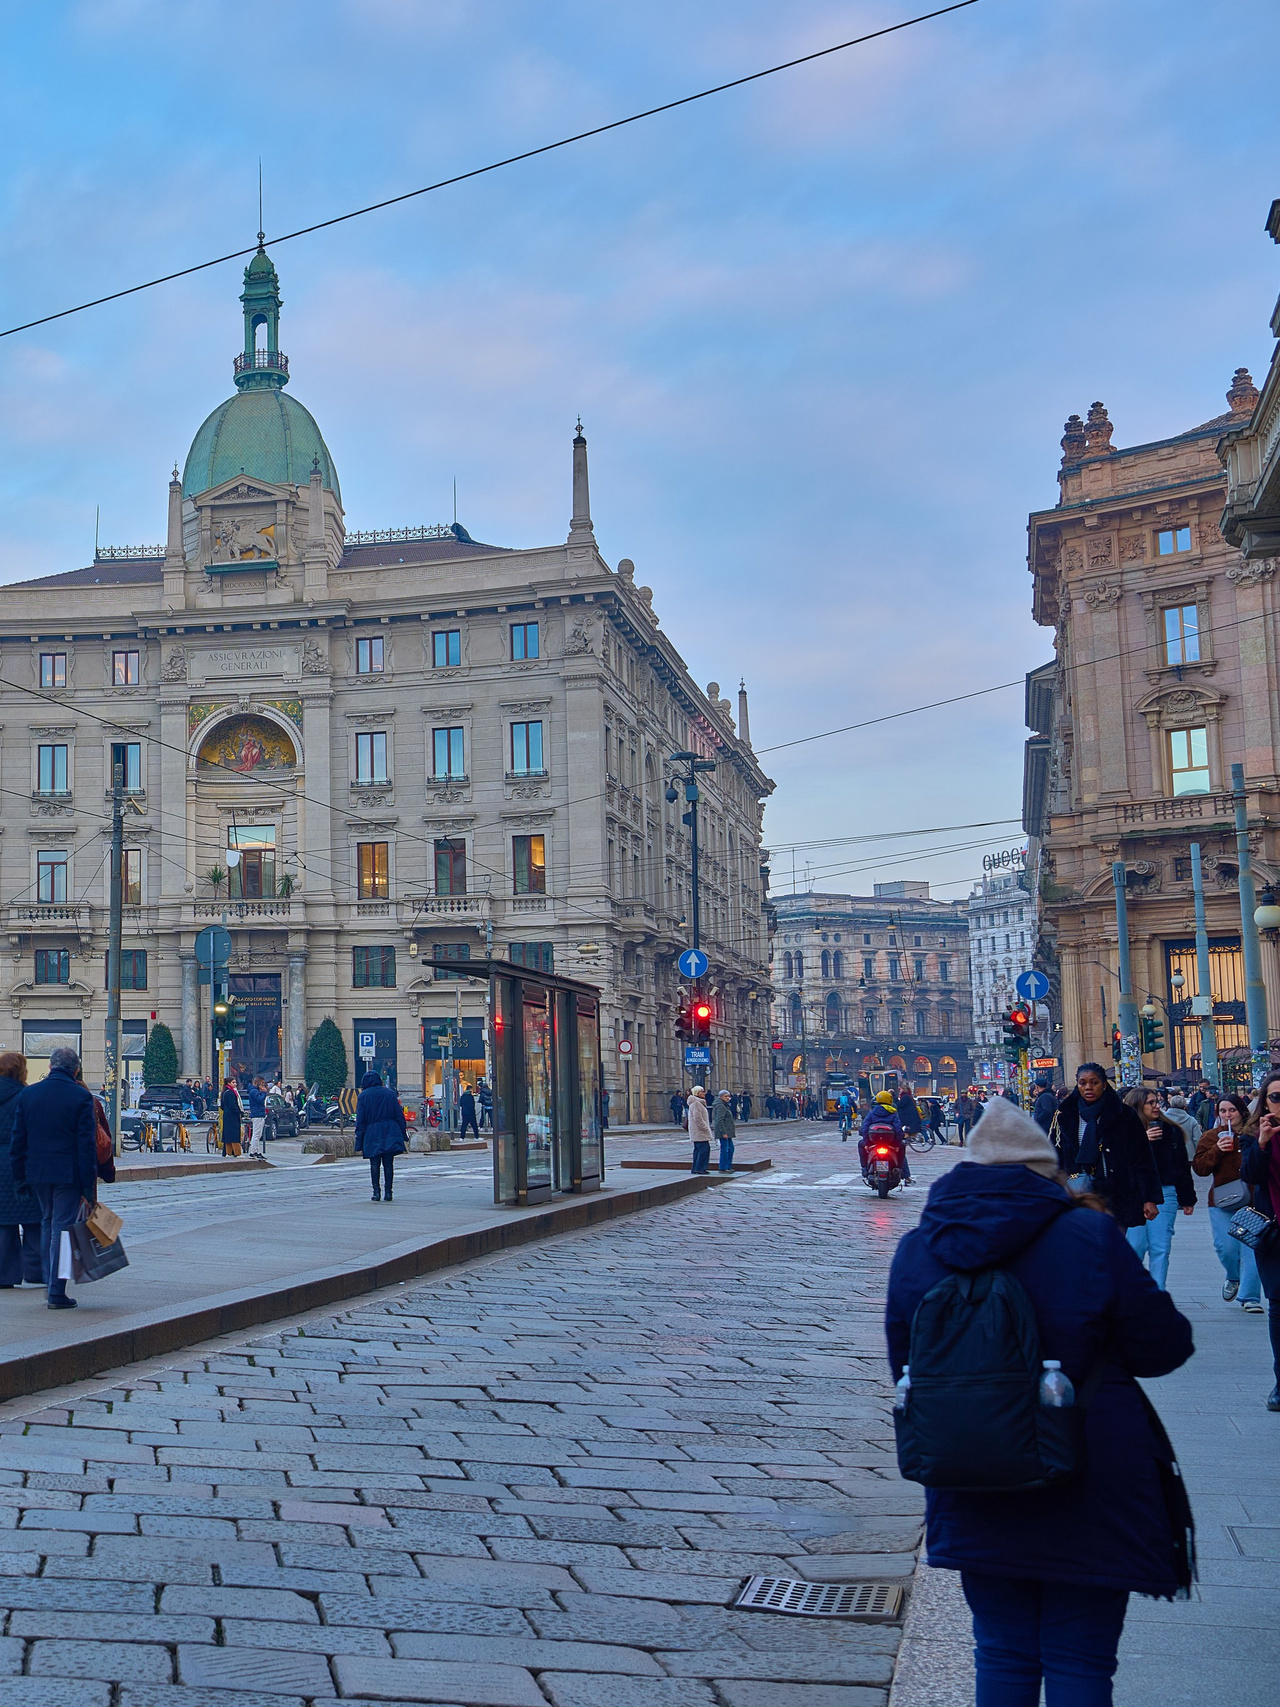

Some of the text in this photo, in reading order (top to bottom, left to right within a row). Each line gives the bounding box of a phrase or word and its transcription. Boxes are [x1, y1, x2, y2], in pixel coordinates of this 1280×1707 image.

[208, 650, 282, 661] ASSICVRAZIONI
[220, 661, 268, 671] GENERALI
[363, 1036, 371, 1046] P
